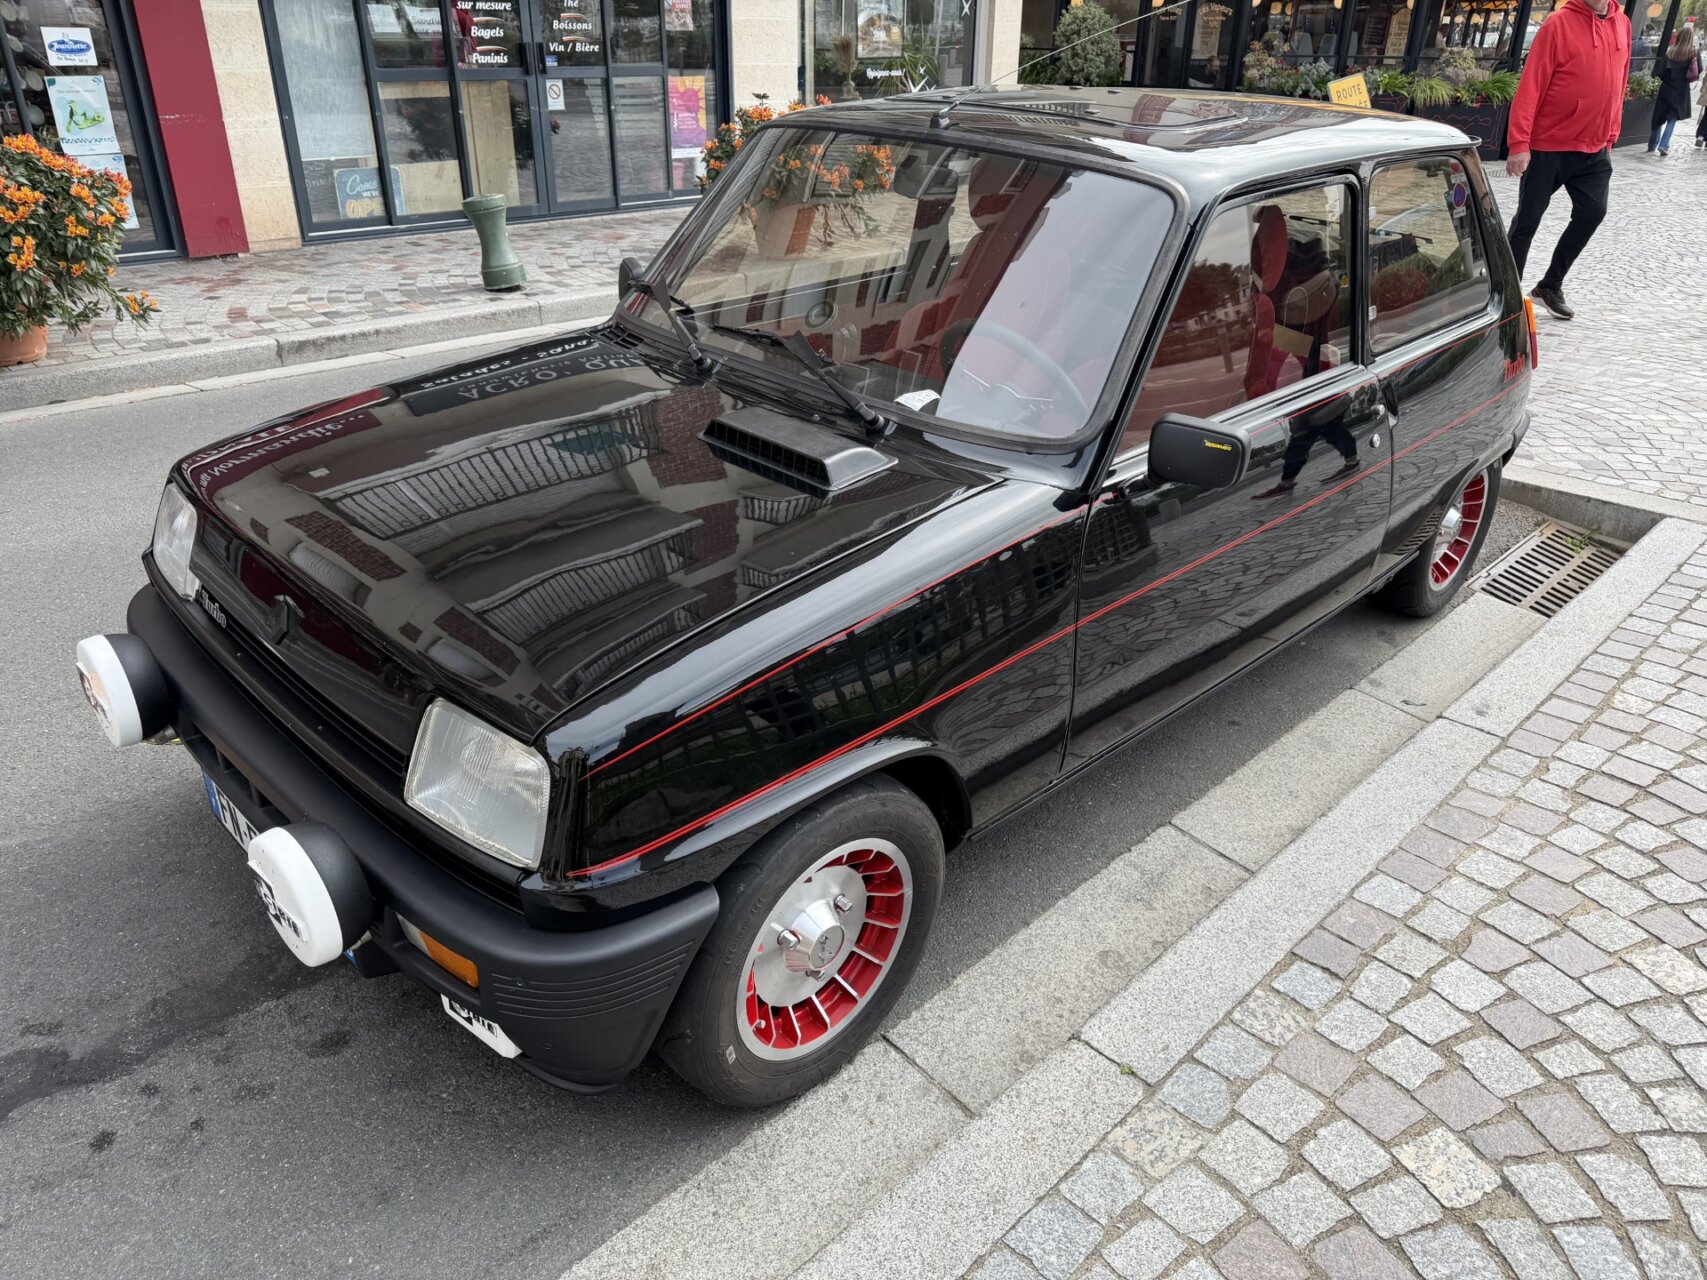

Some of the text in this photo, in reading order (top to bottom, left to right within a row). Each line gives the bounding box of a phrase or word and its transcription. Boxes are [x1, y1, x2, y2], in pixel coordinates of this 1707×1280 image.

[456, 1, 512, 11] sur mesure
[552, 20, 593, 30] Boissons
[470, 26, 504, 40] Bagels
[549, 43, 565, 52] Vin
[575, 42, 600, 52] Bière
[472, 52, 509, 64] Paninis
[1336, 83, 1363, 102] ROUTE
[346, 174, 378, 195] Come
[202, 590, 227, 629] Turbo
